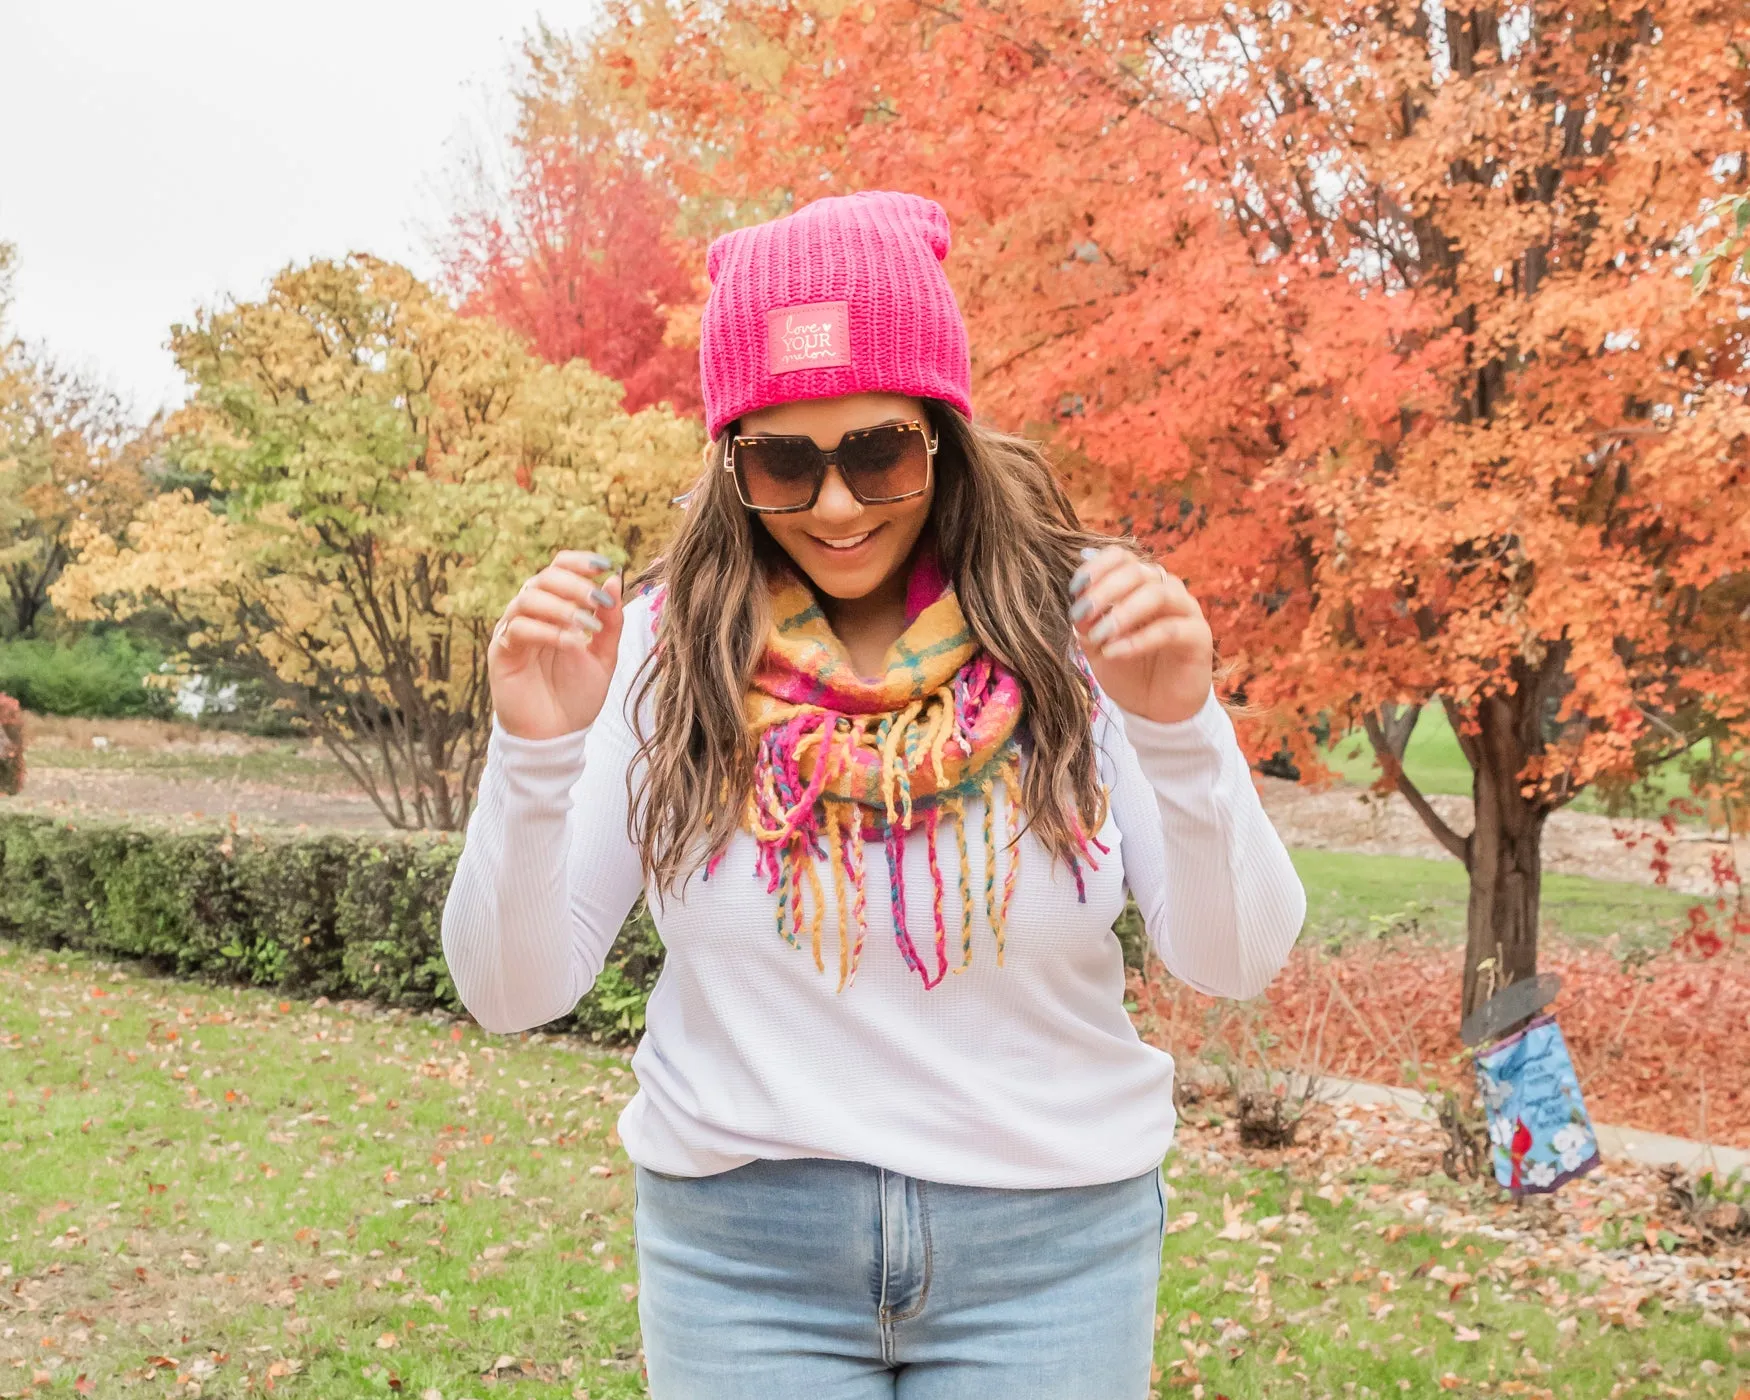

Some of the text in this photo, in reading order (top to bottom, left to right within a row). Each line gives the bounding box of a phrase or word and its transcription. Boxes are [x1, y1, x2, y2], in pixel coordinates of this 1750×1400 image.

[781, 315, 821, 339] love
[783, 333, 832, 352] YOUR
[782, 343, 836, 364] melon
